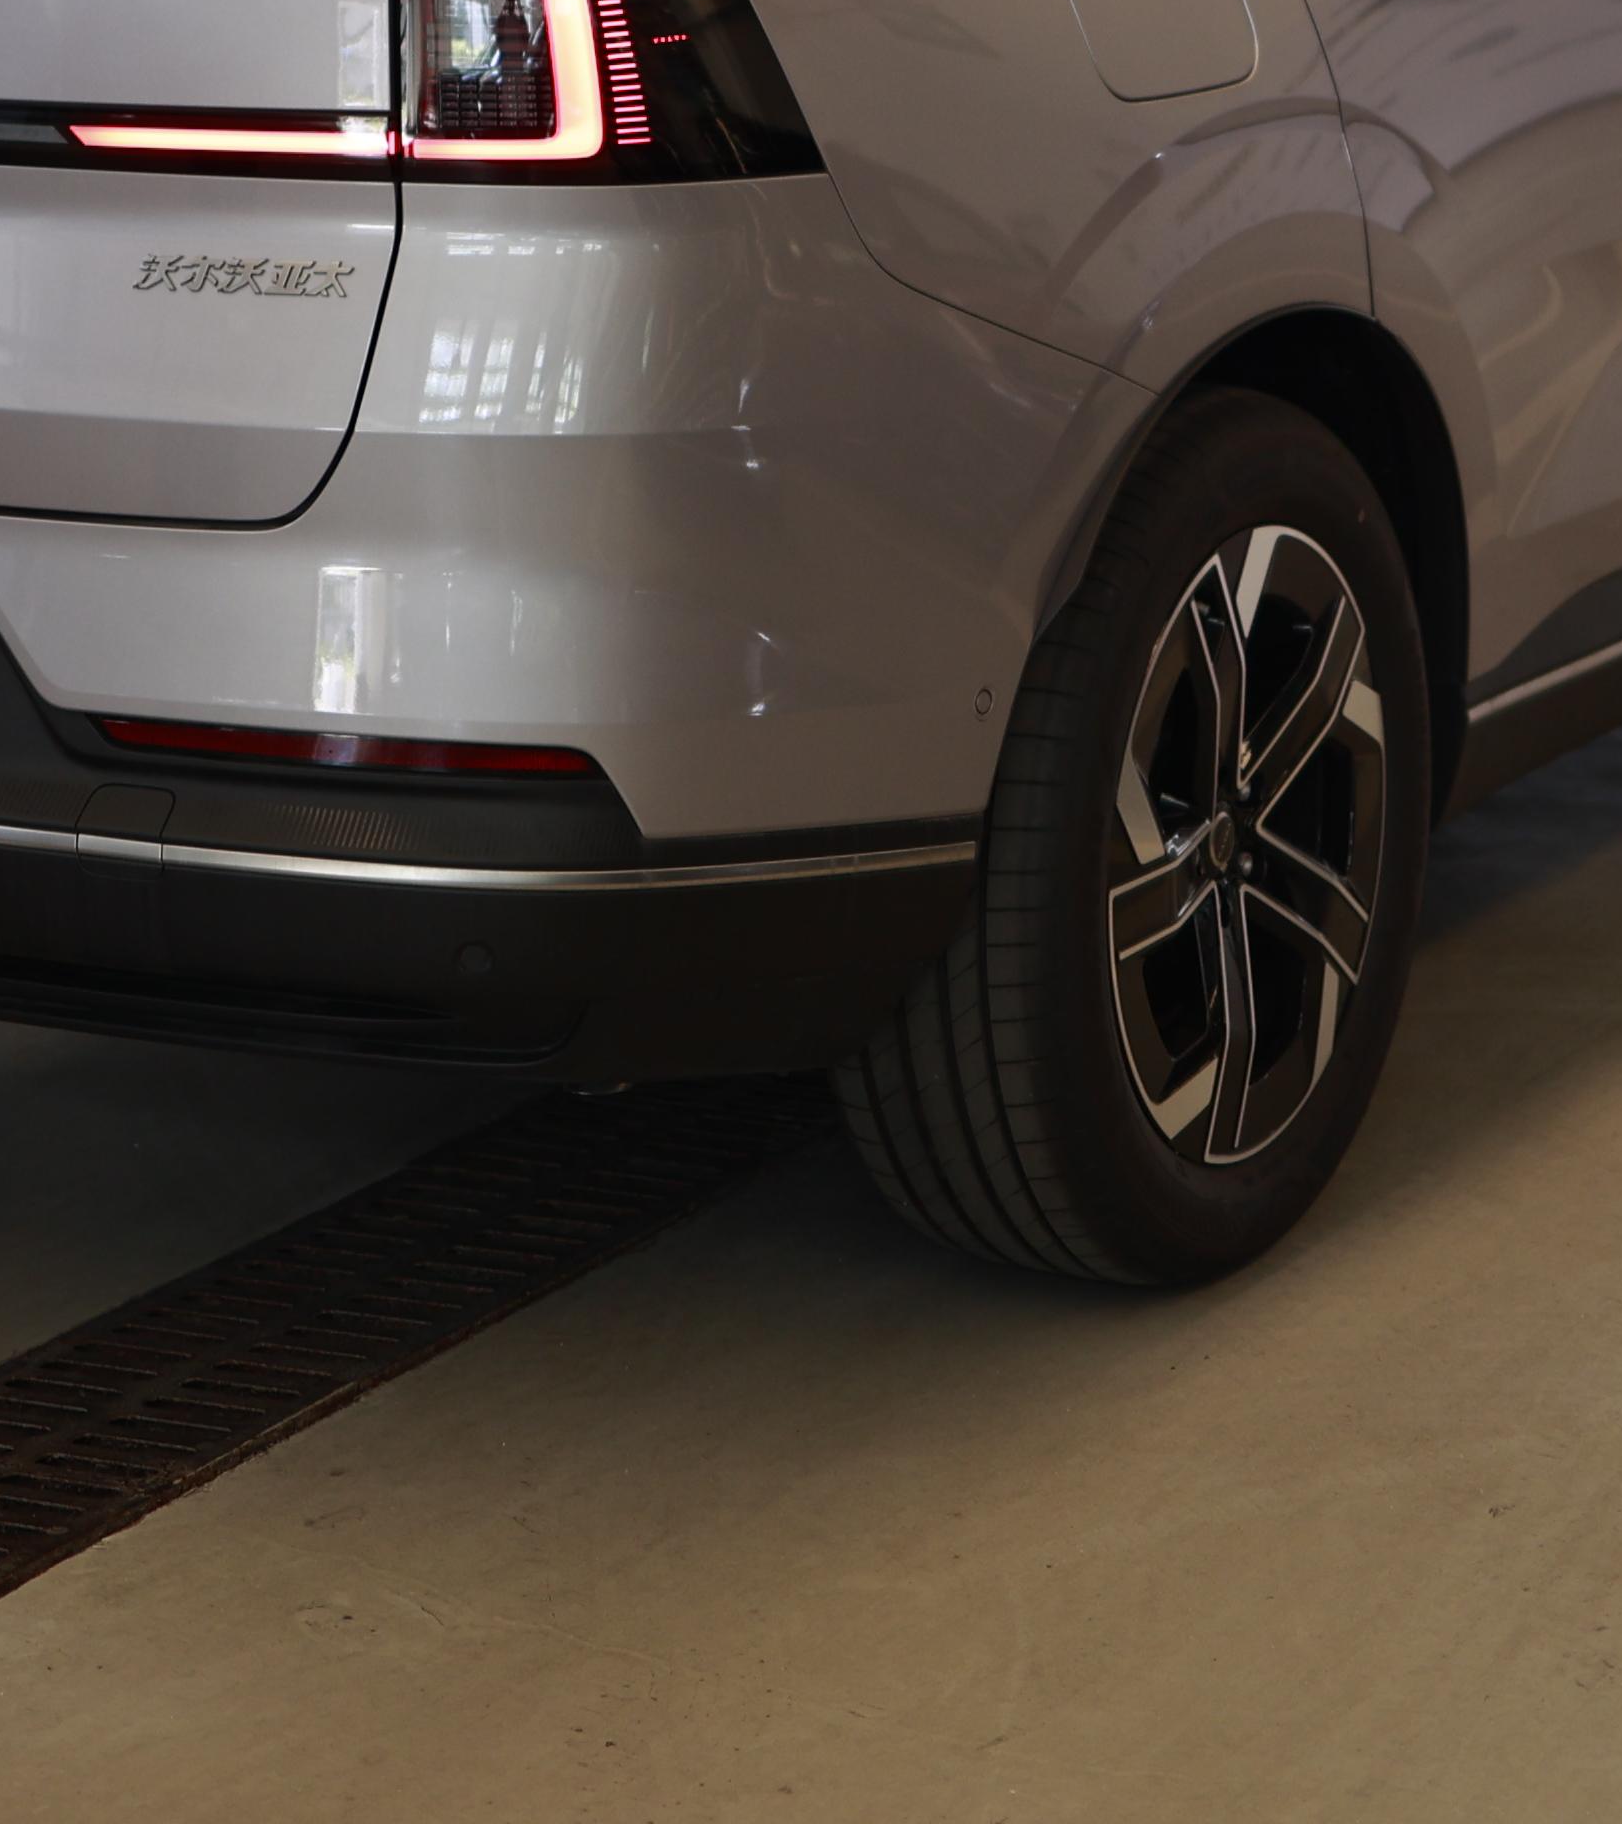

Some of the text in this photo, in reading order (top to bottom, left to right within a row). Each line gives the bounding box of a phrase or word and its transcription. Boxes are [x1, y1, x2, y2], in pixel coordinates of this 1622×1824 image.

[133, 254, 355, 298] 沃尔沃亚太
